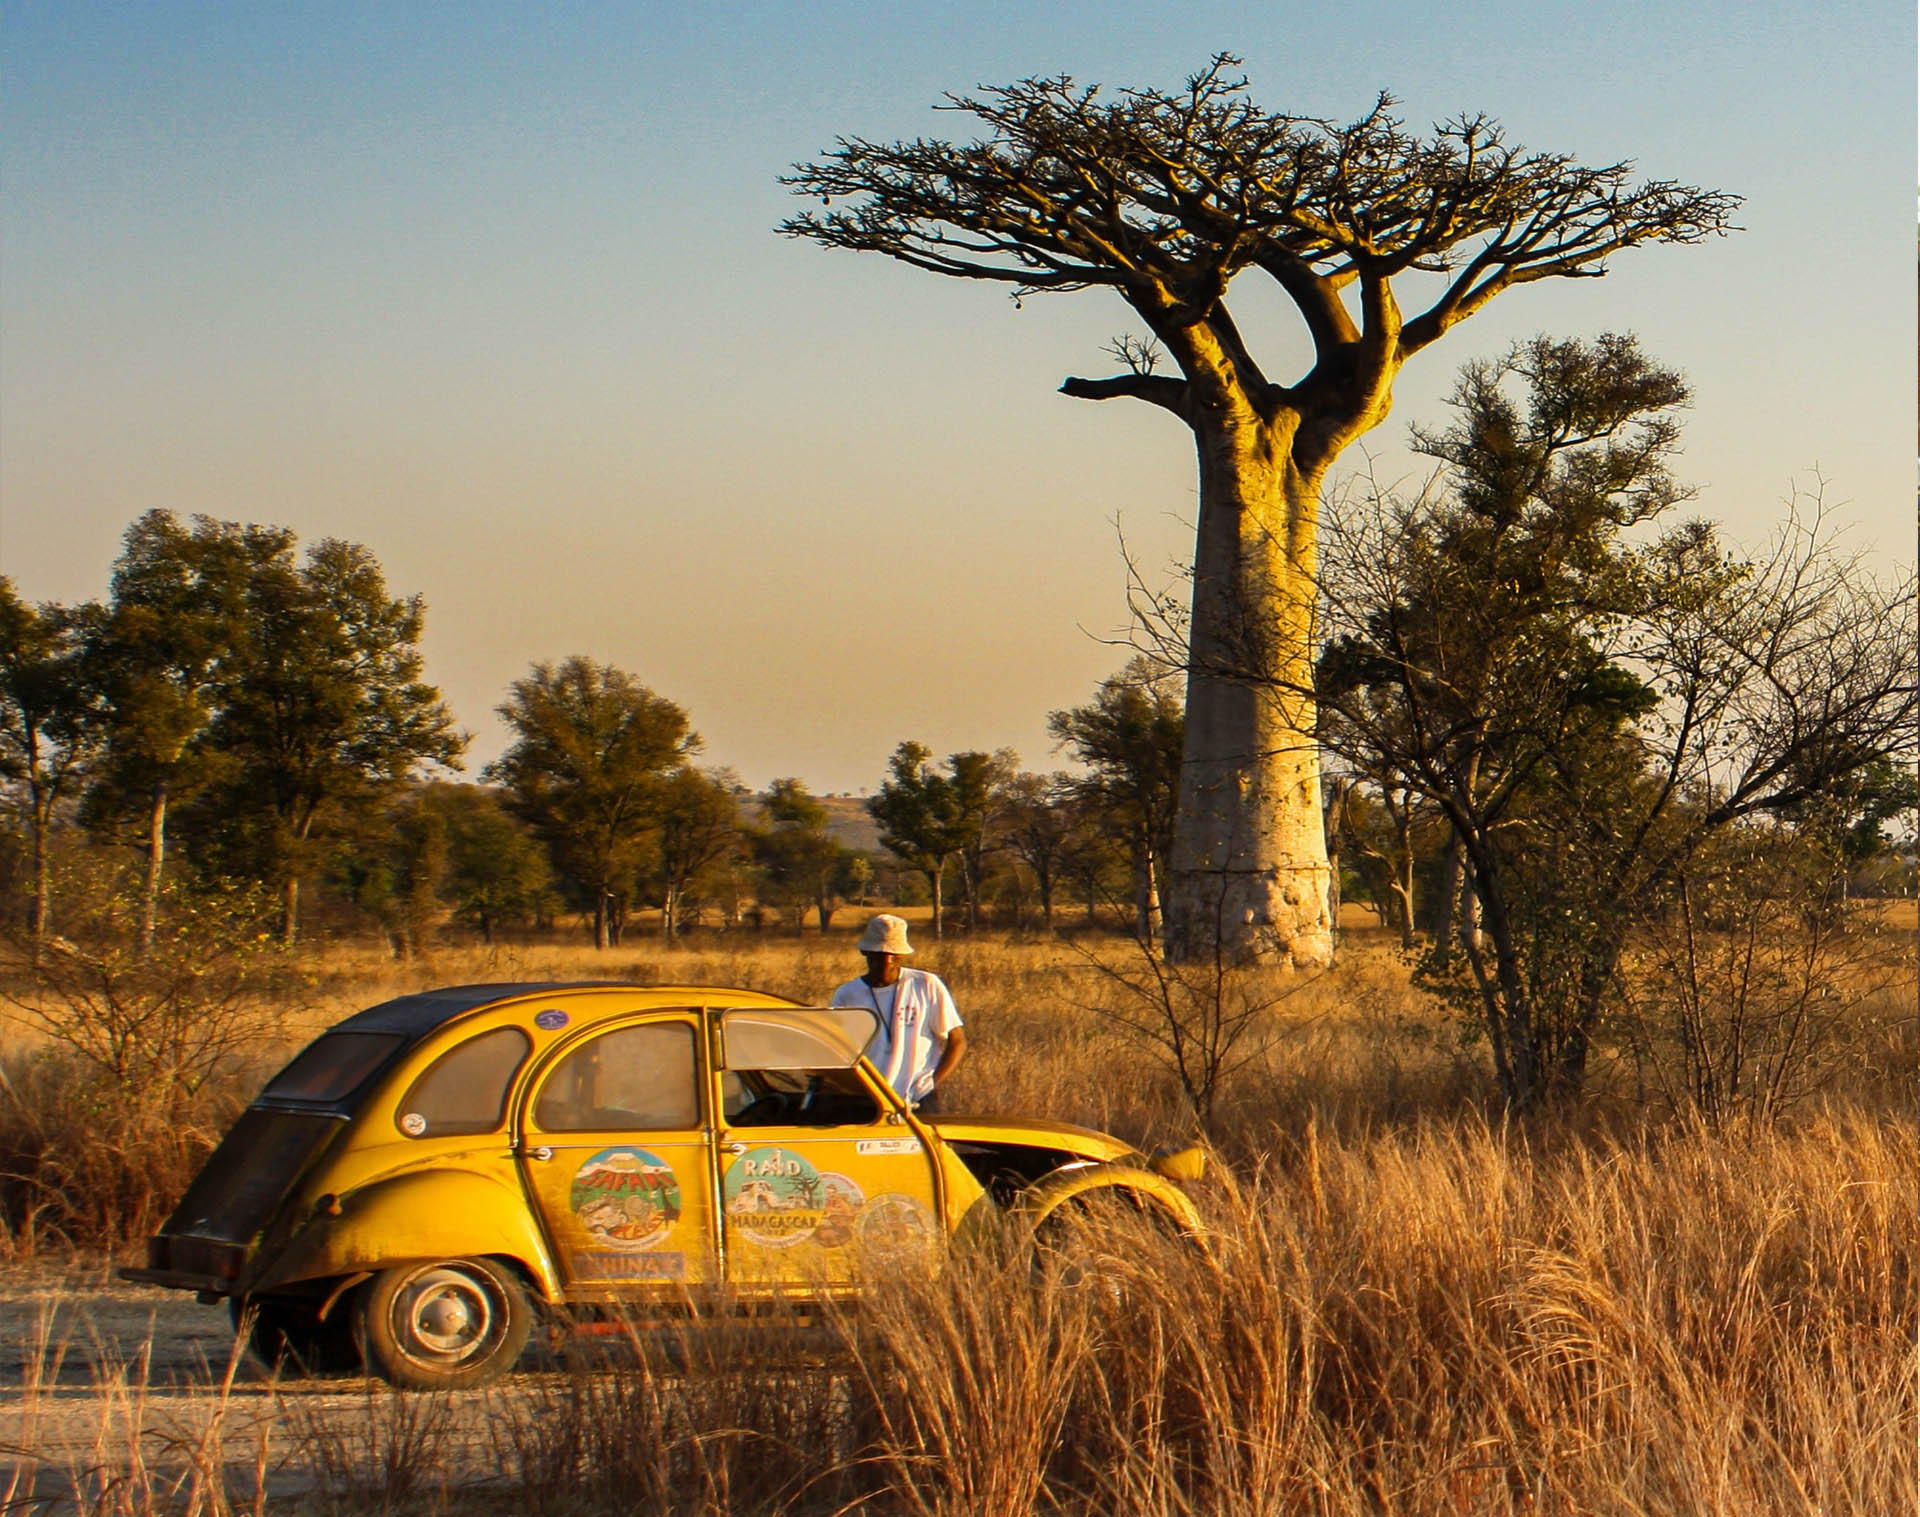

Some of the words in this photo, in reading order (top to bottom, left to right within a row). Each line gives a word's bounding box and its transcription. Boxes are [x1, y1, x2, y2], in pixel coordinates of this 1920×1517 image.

[744, 1157, 801, 1177] RAID
[577, 1168, 678, 1191] SAFARI
[730, 1215, 817, 1229] MADAGASCAR
